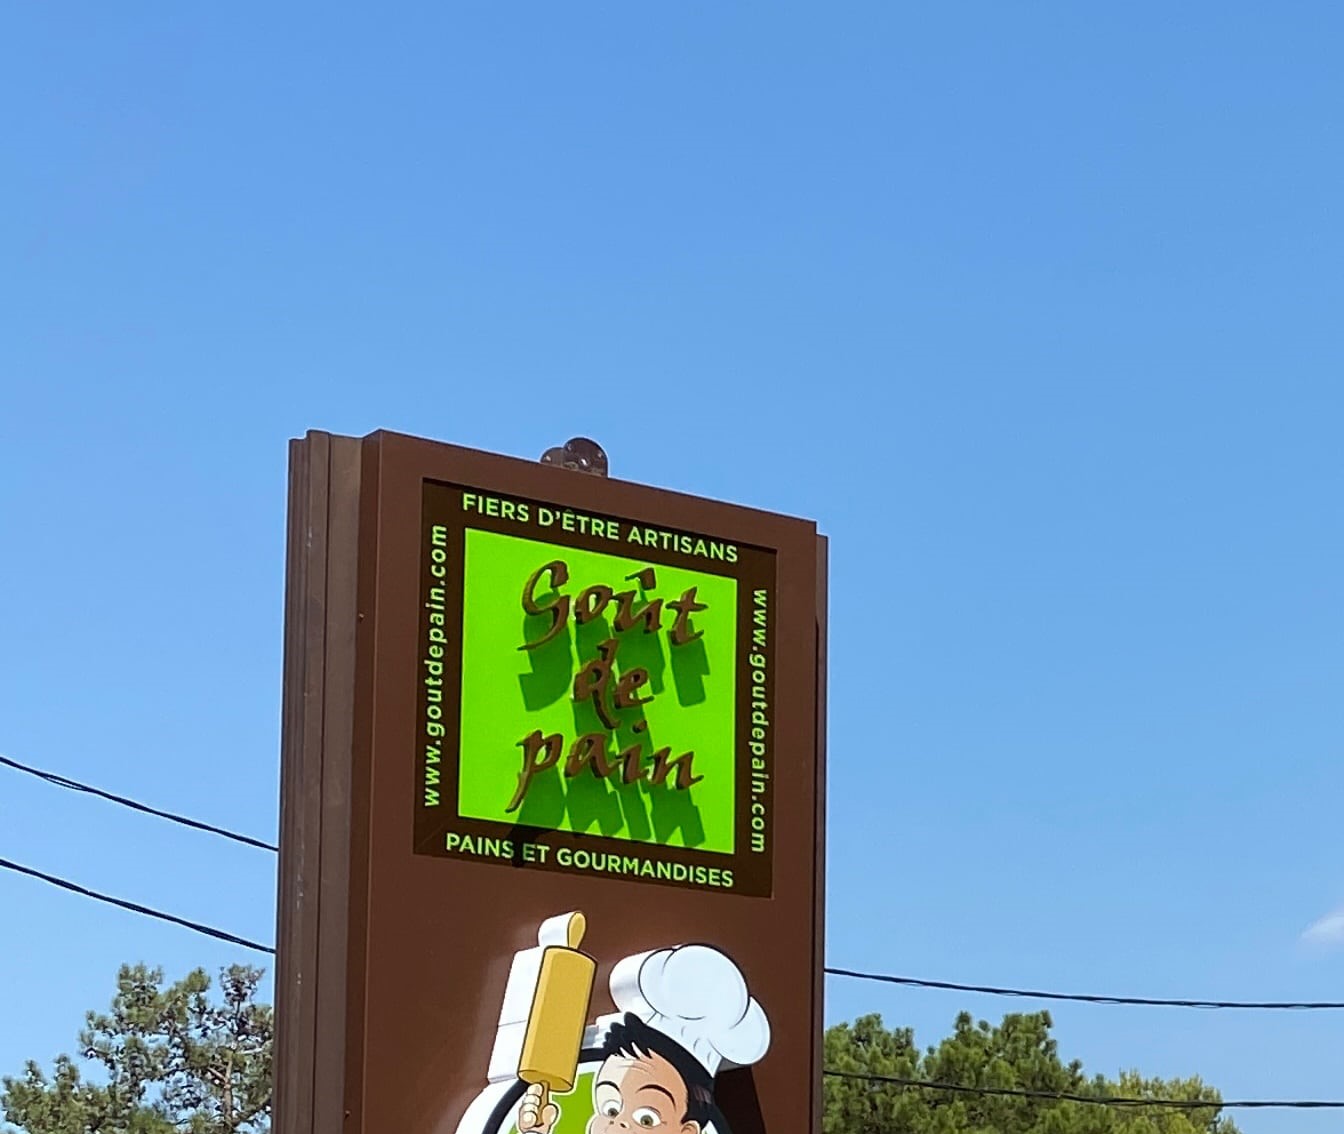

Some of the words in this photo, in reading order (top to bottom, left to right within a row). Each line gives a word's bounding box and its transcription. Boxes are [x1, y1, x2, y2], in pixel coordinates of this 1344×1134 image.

[462, 493, 530, 522] FIERS
[628, 526, 739, 563] ARTISANS
[518, 559, 709, 651] Goût
[424, 525, 448, 808] www.goutdepain.com
[570, 639, 655, 730] de
[505, 718, 705, 813] pain
[749, 589, 768, 853] www.goutdepain.com
[446, 833, 514, 859] PAINS
[522, 843, 550, 863] ET
[557, 847, 734, 888] GOURMANDISES
